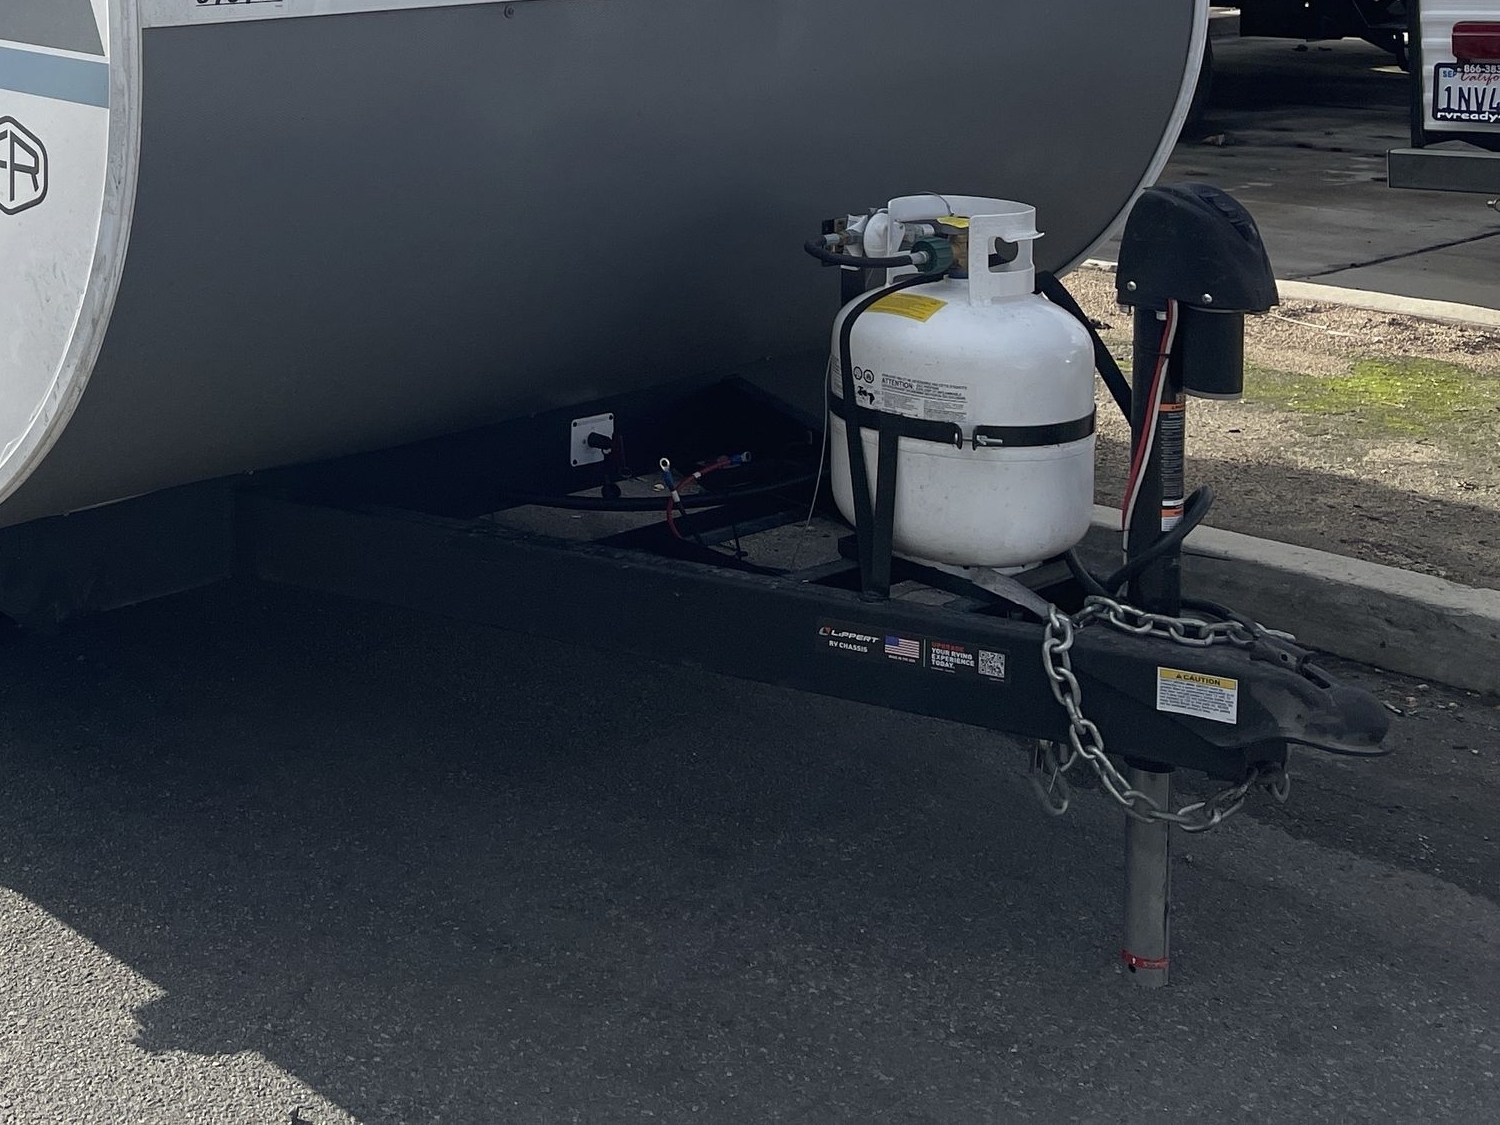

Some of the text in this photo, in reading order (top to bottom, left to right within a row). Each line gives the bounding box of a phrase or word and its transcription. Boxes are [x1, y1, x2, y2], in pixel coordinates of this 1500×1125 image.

[1437, 111, 1500, 123] rvready
[839, 642, 868, 653] CHASSIS
[931, 647, 950, 656] YOUR
[931, 653, 975, 667] EXPERIENCE
[1183, 674, 1221, 686] CAUTION
